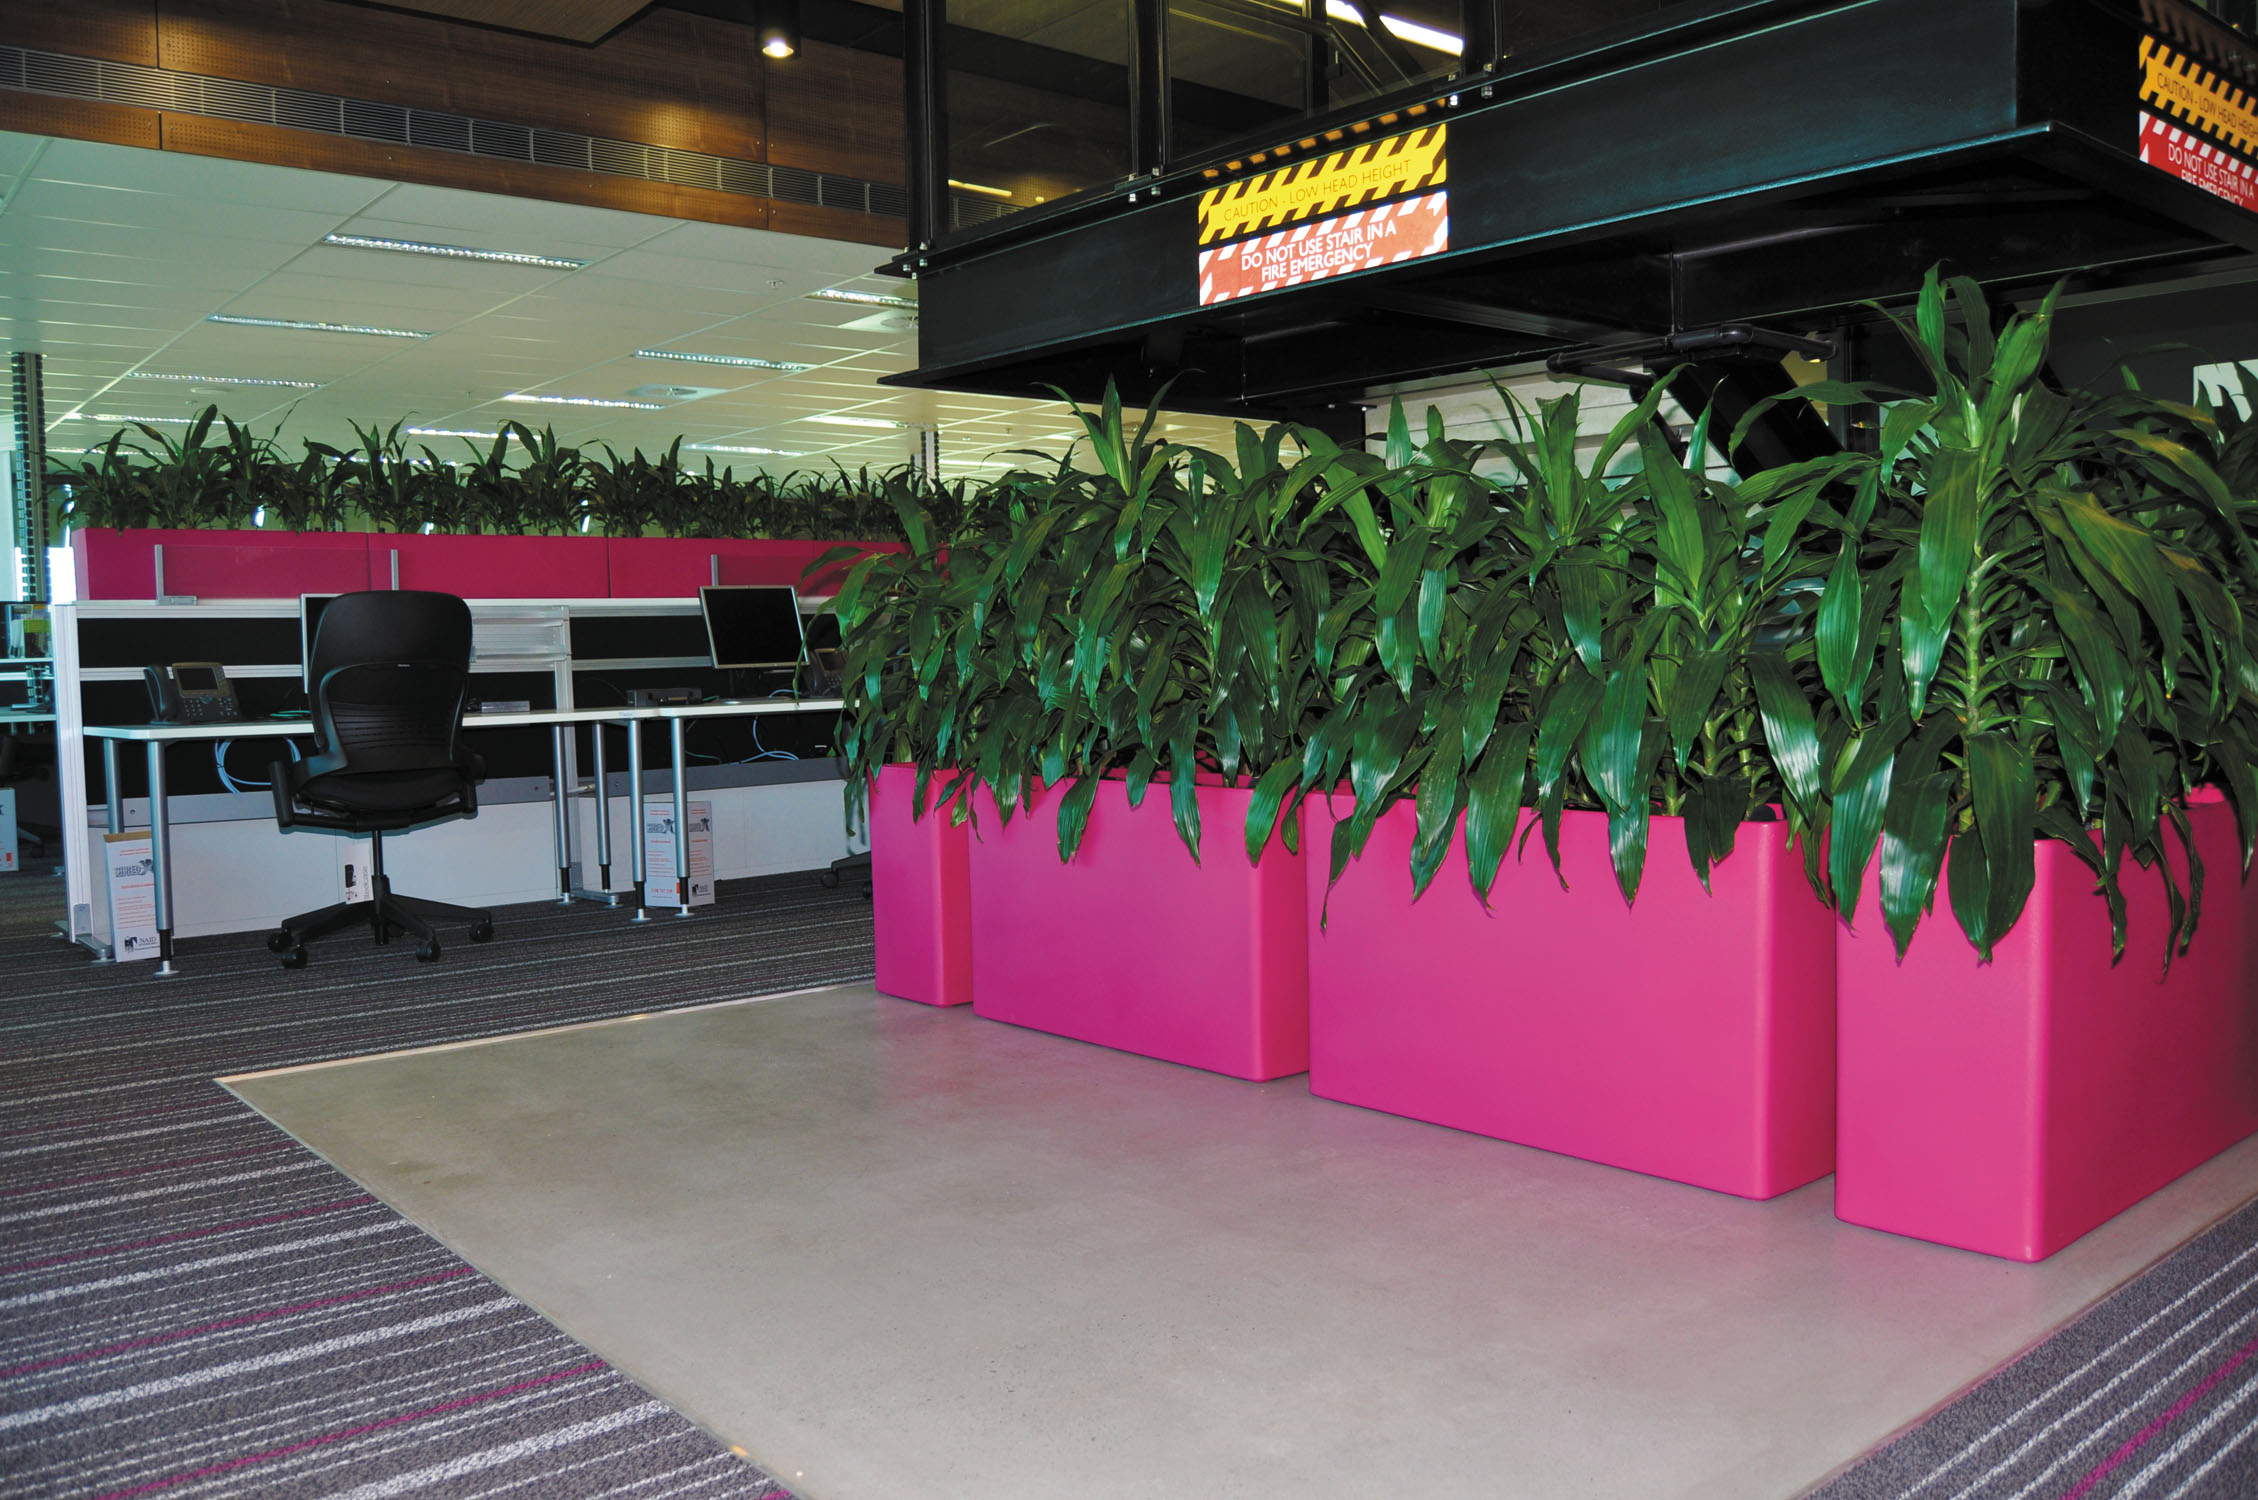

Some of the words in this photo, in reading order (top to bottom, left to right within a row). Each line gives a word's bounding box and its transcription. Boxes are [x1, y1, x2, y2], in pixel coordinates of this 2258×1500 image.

[2157, 72, 2193, 105] CAUTION
[2199, 97, 2216, 116] LOW
[2217, 106, 2236, 128] HEAD
[2238, 117, 2258, 140] HEIGH
[1224, 197, 1278, 222] CAUTION
[1289, 186, 1319, 204] LOW
[1323, 174, 1357, 197] HEAD
[1362, 159, 1411, 184] HEIGHT
[2168, 143, 2182, 165] DO
[2184, 151, 2202, 175] NOT
[2204, 160, 2218, 182] USE
[2219, 168, 2239, 193] STAIR
[2240, 178, 2249, 197] IN
[2249, 184, 2255, 200] A
[1241, 252, 1263, 271] DO
[1266, 243, 1296, 265] NOT
[1299, 234, 1324, 256] USE
[1326, 226, 1364, 251] STAIR
[1367, 220, 1383, 241] IN
[1385, 219, 1397, 237] A
[1261, 262, 1287, 282] FIRE
[1290, 242, 1374, 276] EMERGENCY
